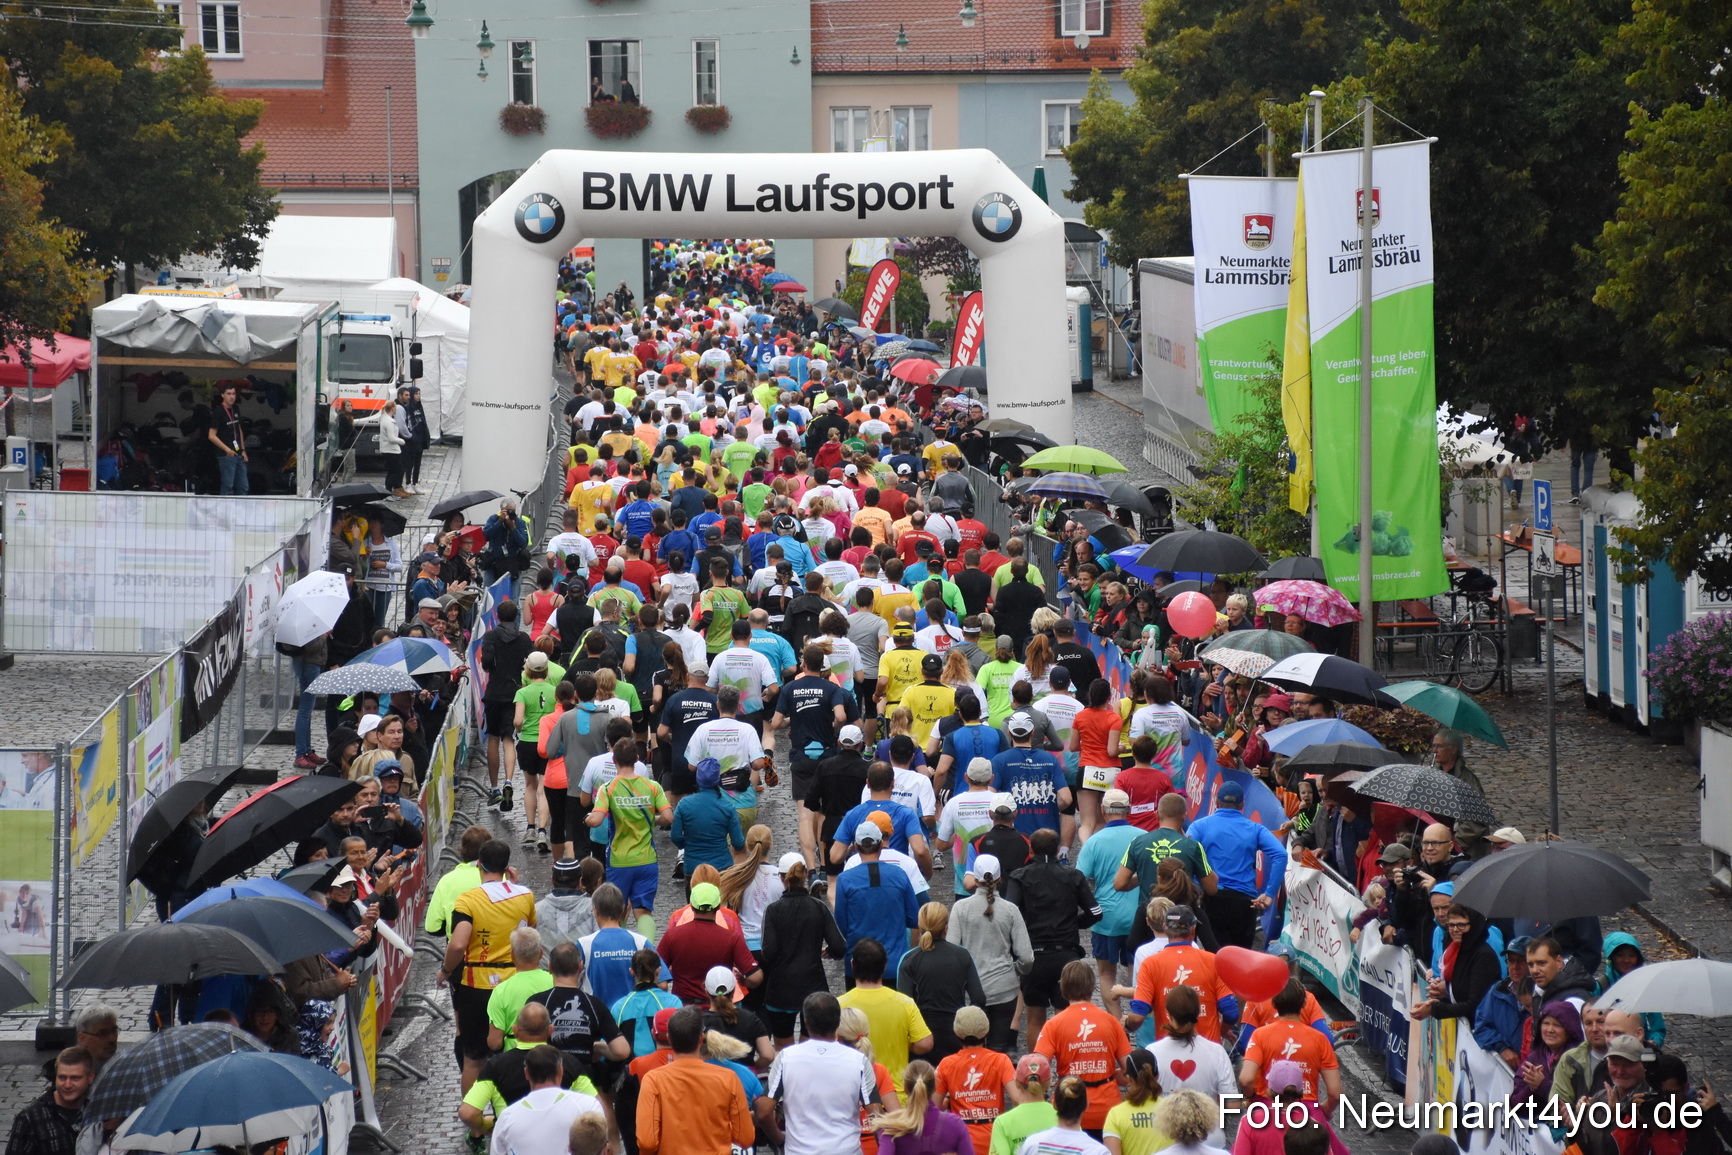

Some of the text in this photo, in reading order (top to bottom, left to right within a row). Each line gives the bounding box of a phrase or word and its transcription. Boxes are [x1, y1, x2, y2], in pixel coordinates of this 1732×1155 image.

[582, 171, 955, 219] BMW Laufsport
[519, 194, 560, 211] BMW
[978, 193, 1019, 211] BMW
[1220, 255, 1291, 268] Neumarkte
[862, 268, 895, 330] REWE
[954, 303, 984, 367] EWE
[1399, 350, 1429, 361] leben.
[471, 401, 541, 411] www.bmw-laufsport.de
[996, 399, 1066, 408] www.bmw-laufsport.de
[15, 451, 24, 463] P
[1537, 486, 1548, 523] P
[1539, 537, 1548, 545] nur
[681, 700, 712, 708] RICHTER
[1093, 771, 1105, 781] 45
[1068, 1041, 1103, 1052] funrunners
[1079, 1045, 1108, 1053] neumarkt
[1069, 1060, 1107, 1071] STIEGLER
[955, 1089, 990, 1100] funrunners
[965, 1093, 997, 1103] neumarkt
[959, 1107, 999, 1118] STIEGLER
